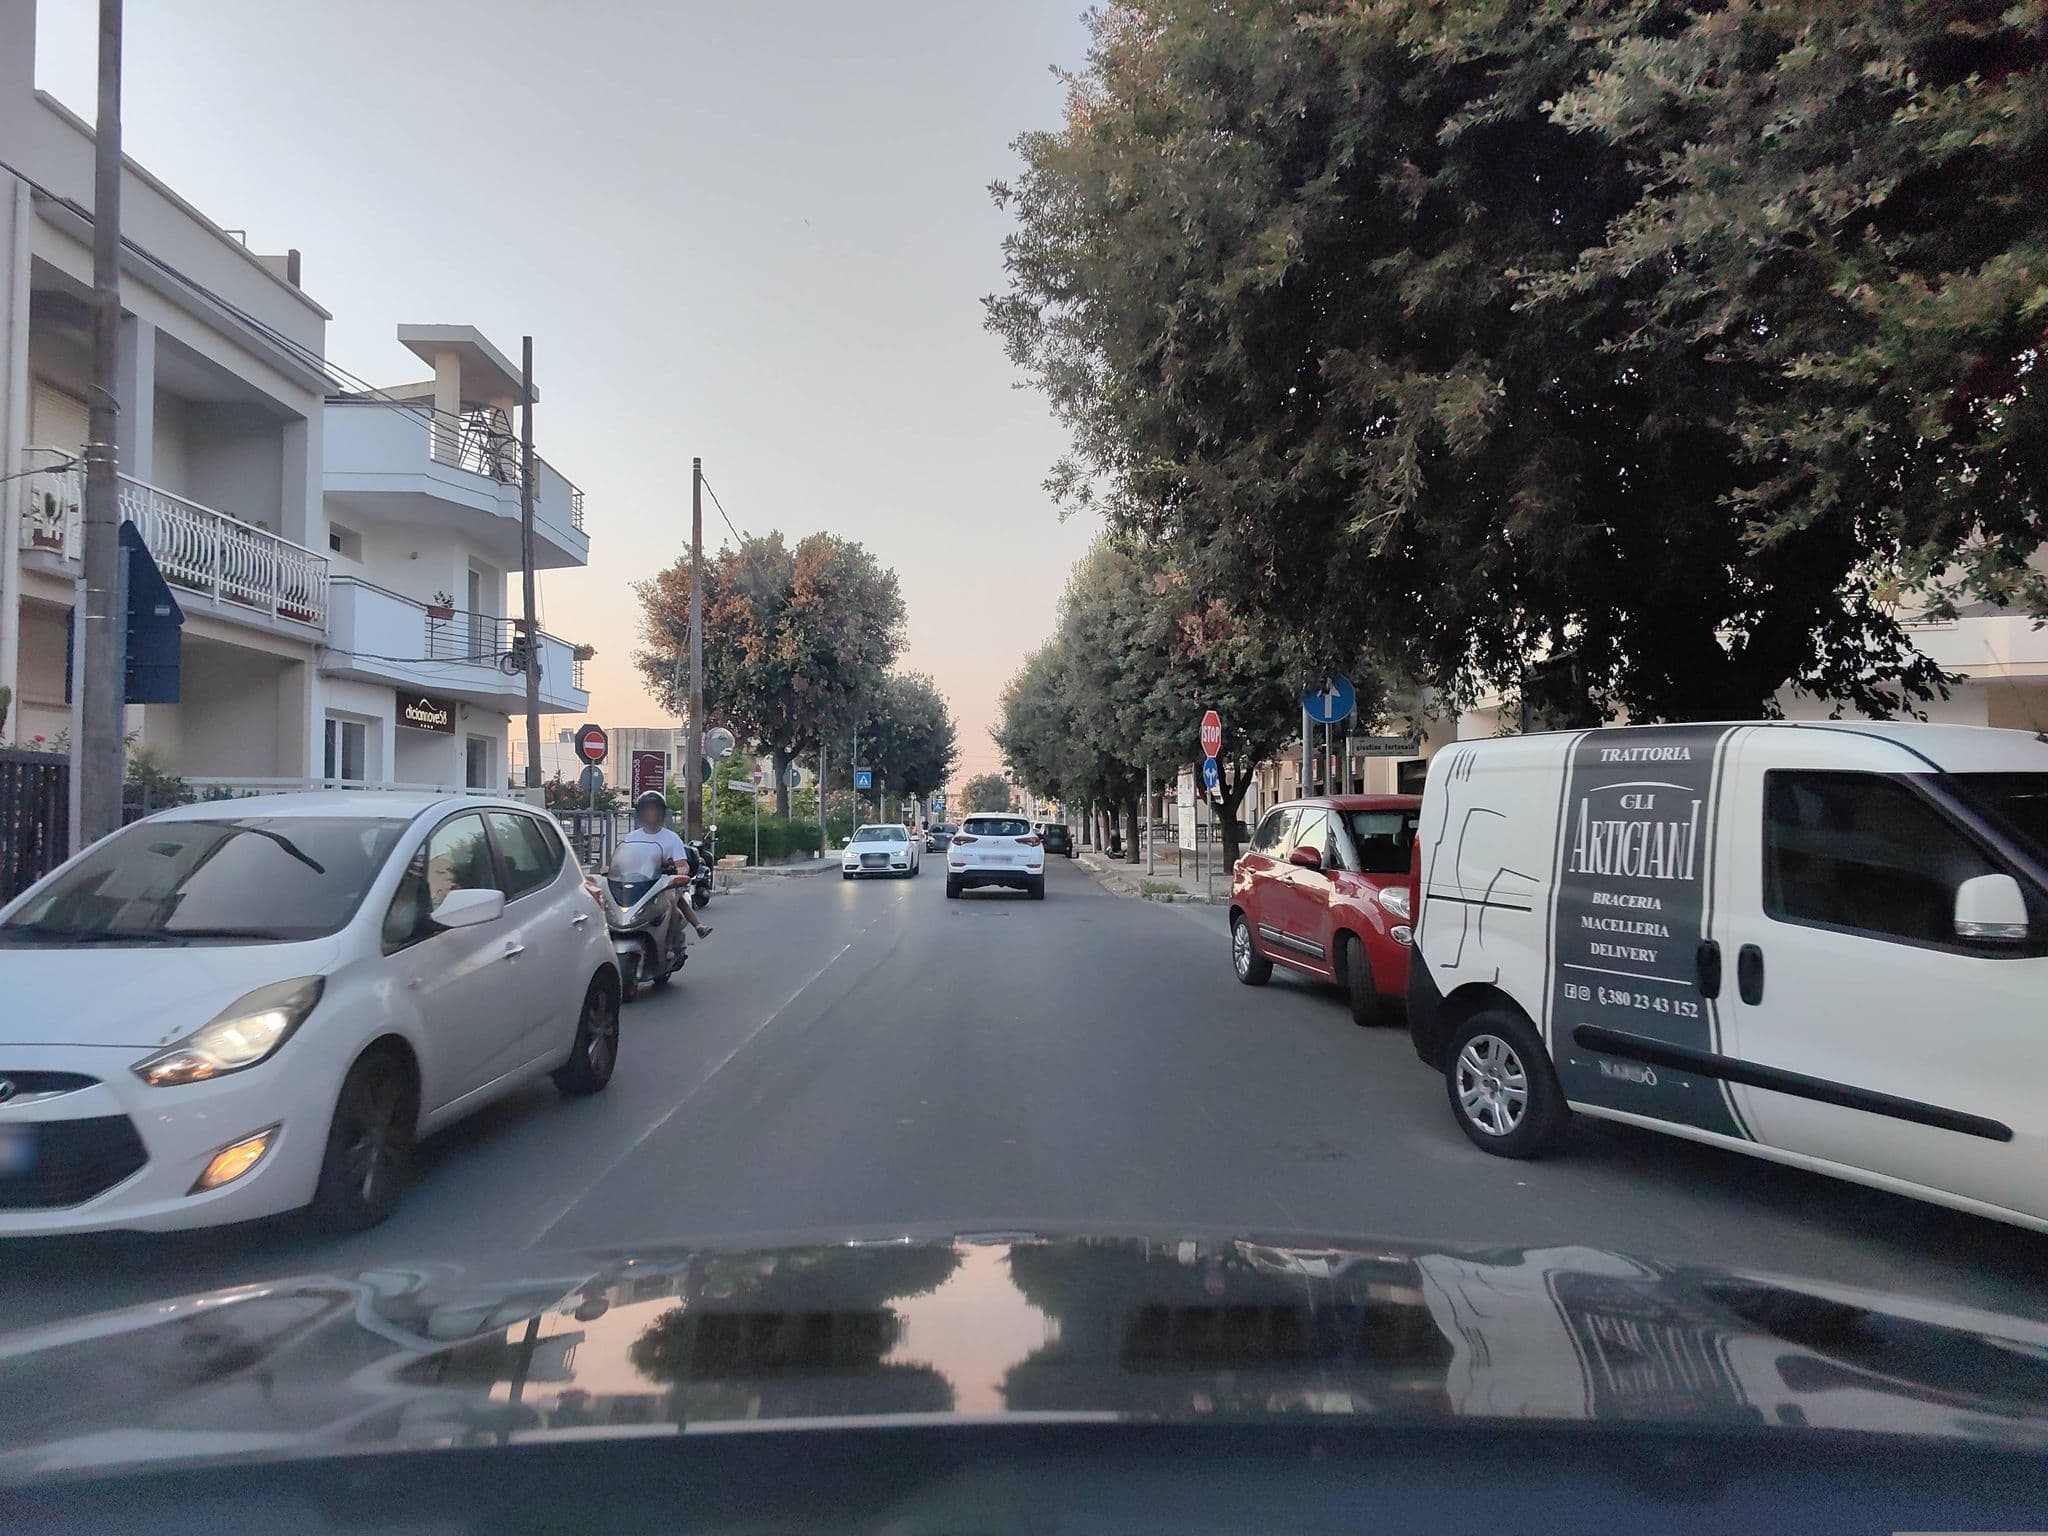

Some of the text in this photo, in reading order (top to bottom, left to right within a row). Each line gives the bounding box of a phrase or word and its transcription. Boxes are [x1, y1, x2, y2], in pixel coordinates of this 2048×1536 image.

[406, 704, 447, 725] diciannove58
[1203, 725, 1220, 743] STOP
[1600, 747, 1691, 762] TRATTORIA
[1620, 794, 1656, 810] GLI
[1568, 798, 1702, 880] ARTIGIANI
[1592, 892, 1662, 910] BRACERIA
[1581, 916, 1670, 938] MACELLERIA
[1590, 942, 1658, 963] DELIVERY
[1608, 989, 1698, 1018] 380 23 43 152
